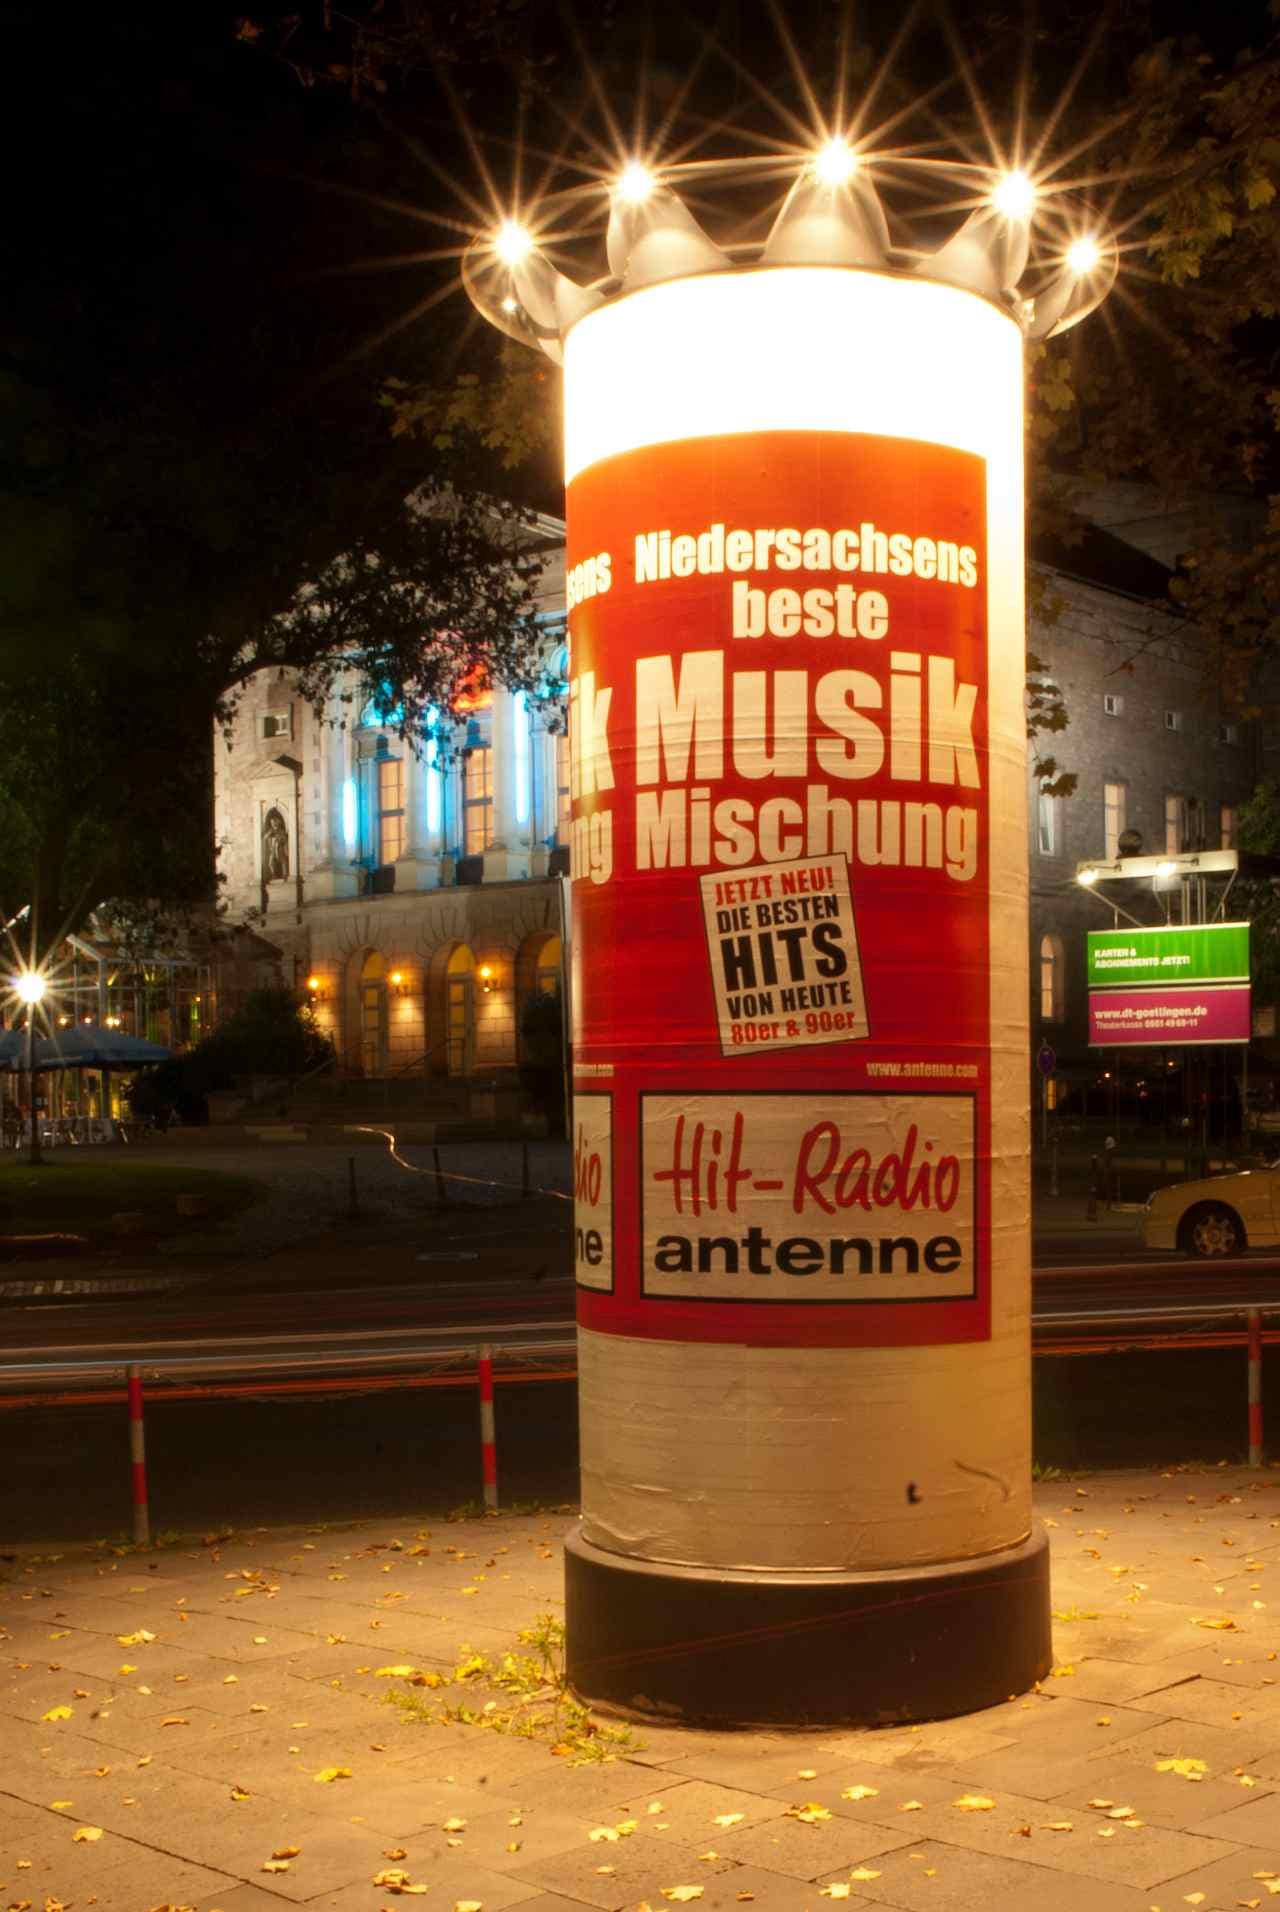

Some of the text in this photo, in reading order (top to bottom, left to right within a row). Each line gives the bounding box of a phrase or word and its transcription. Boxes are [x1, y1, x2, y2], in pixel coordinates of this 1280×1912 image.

[634, 523, 978, 587] Niedersachsens
[732, 580, 889, 640] beste
[635, 650, 980, 789] Musik
[636, 785, 978, 881] Mischung
[715, 866, 834, 906] JETZT NEU!
[716, 894, 840, 934] DIE BESTEN
[721, 923, 848, 992] HITS
[726, 981, 853, 1020] VON HEUTE
[1094, 1006, 1208, 1019] www.dt-goettingen.de
[731, 1011, 855, 1046] 80er & 90er
[866, 1062, 978, 1078] www.antenne.com
[653, 1111, 961, 1217] Hit-Radio
[654, 1227, 963, 1275] antenne
